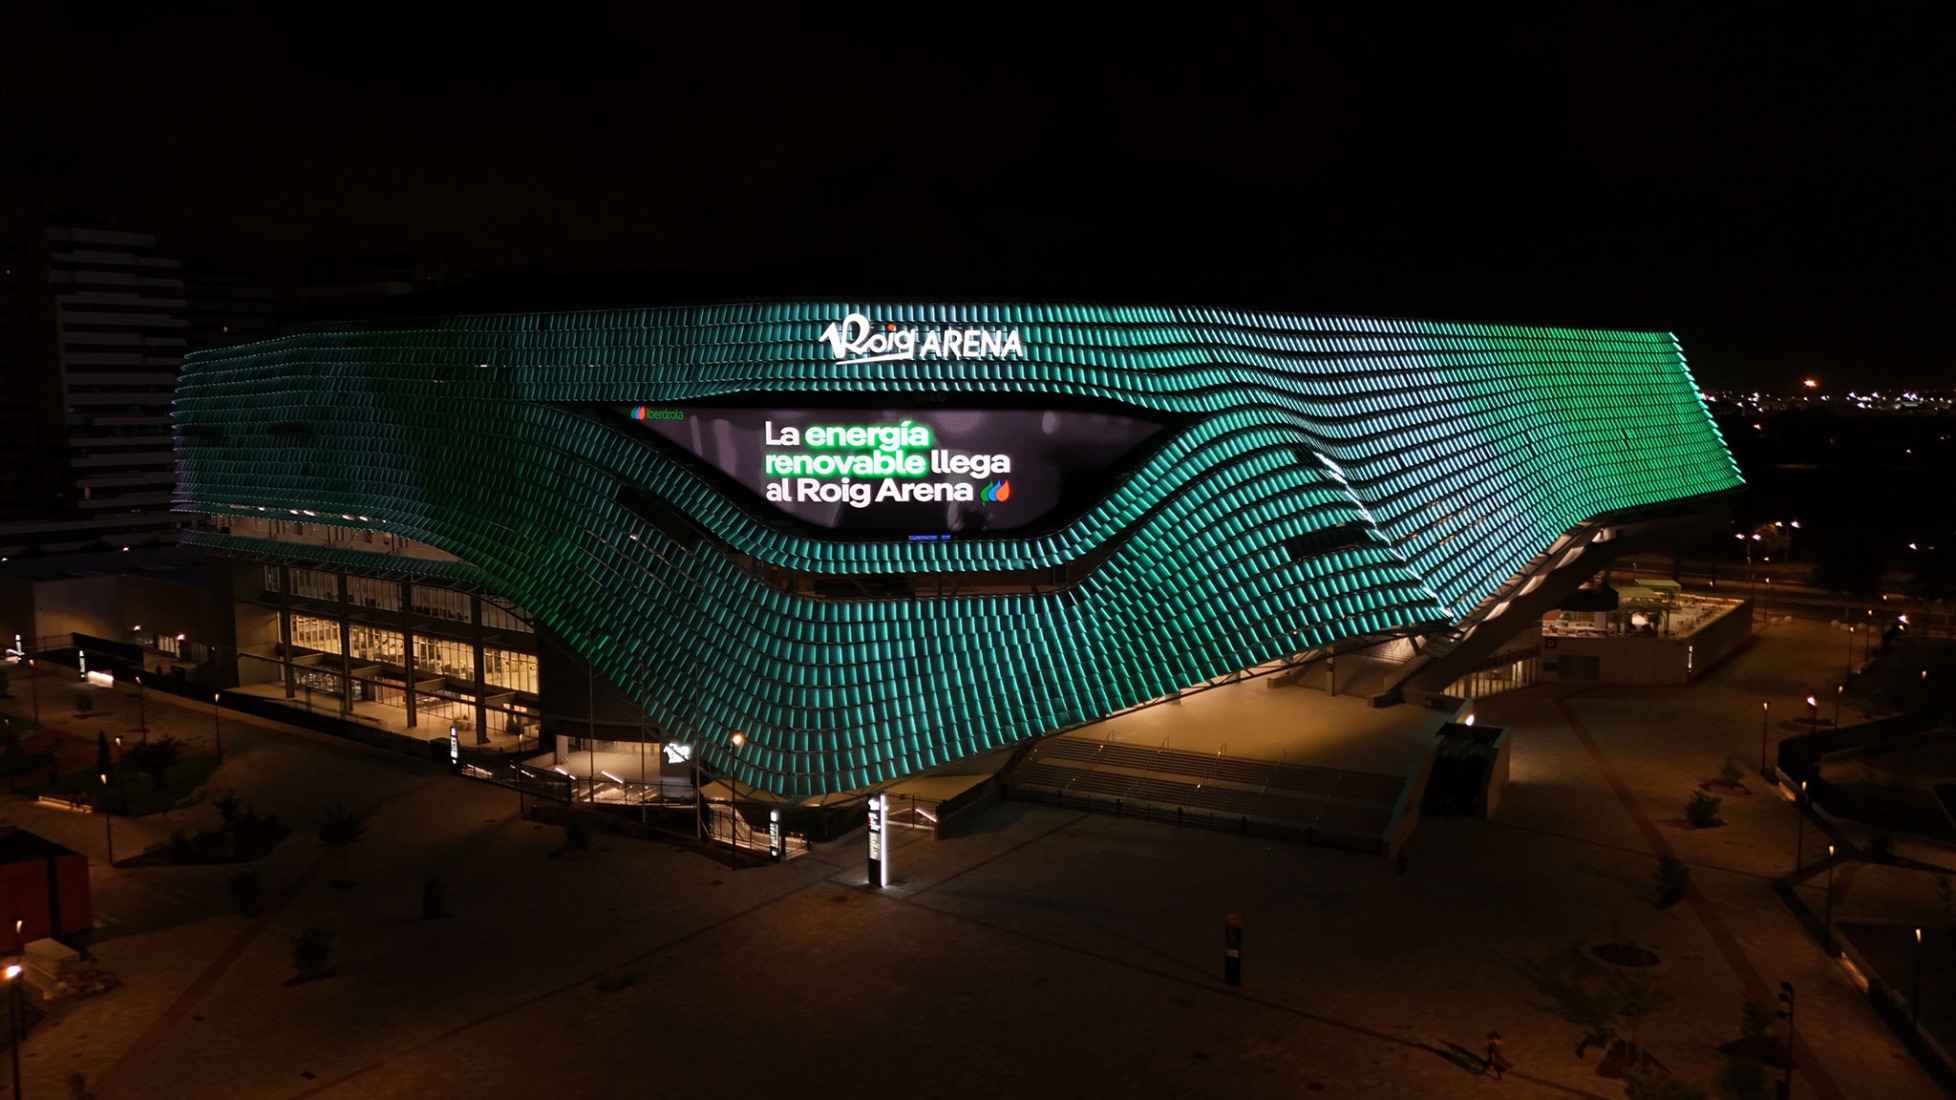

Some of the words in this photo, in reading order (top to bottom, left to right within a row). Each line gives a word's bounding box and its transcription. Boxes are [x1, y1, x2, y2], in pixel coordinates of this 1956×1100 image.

[818, 313, 915, 364] Roig
[919, 329, 1023, 357] ARENA
[646, 408, 684, 420] Iberdrola
[765, 421, 800, 446] La
[805, 421, 929, 452] energía
[765, 450, 926, 475] renovable
[931, 450, 1011, 479] llega
[766, 478, 792, 502] al
[797, 478, 871, 508] Roig
[874, 478, 974, 502] Arena
